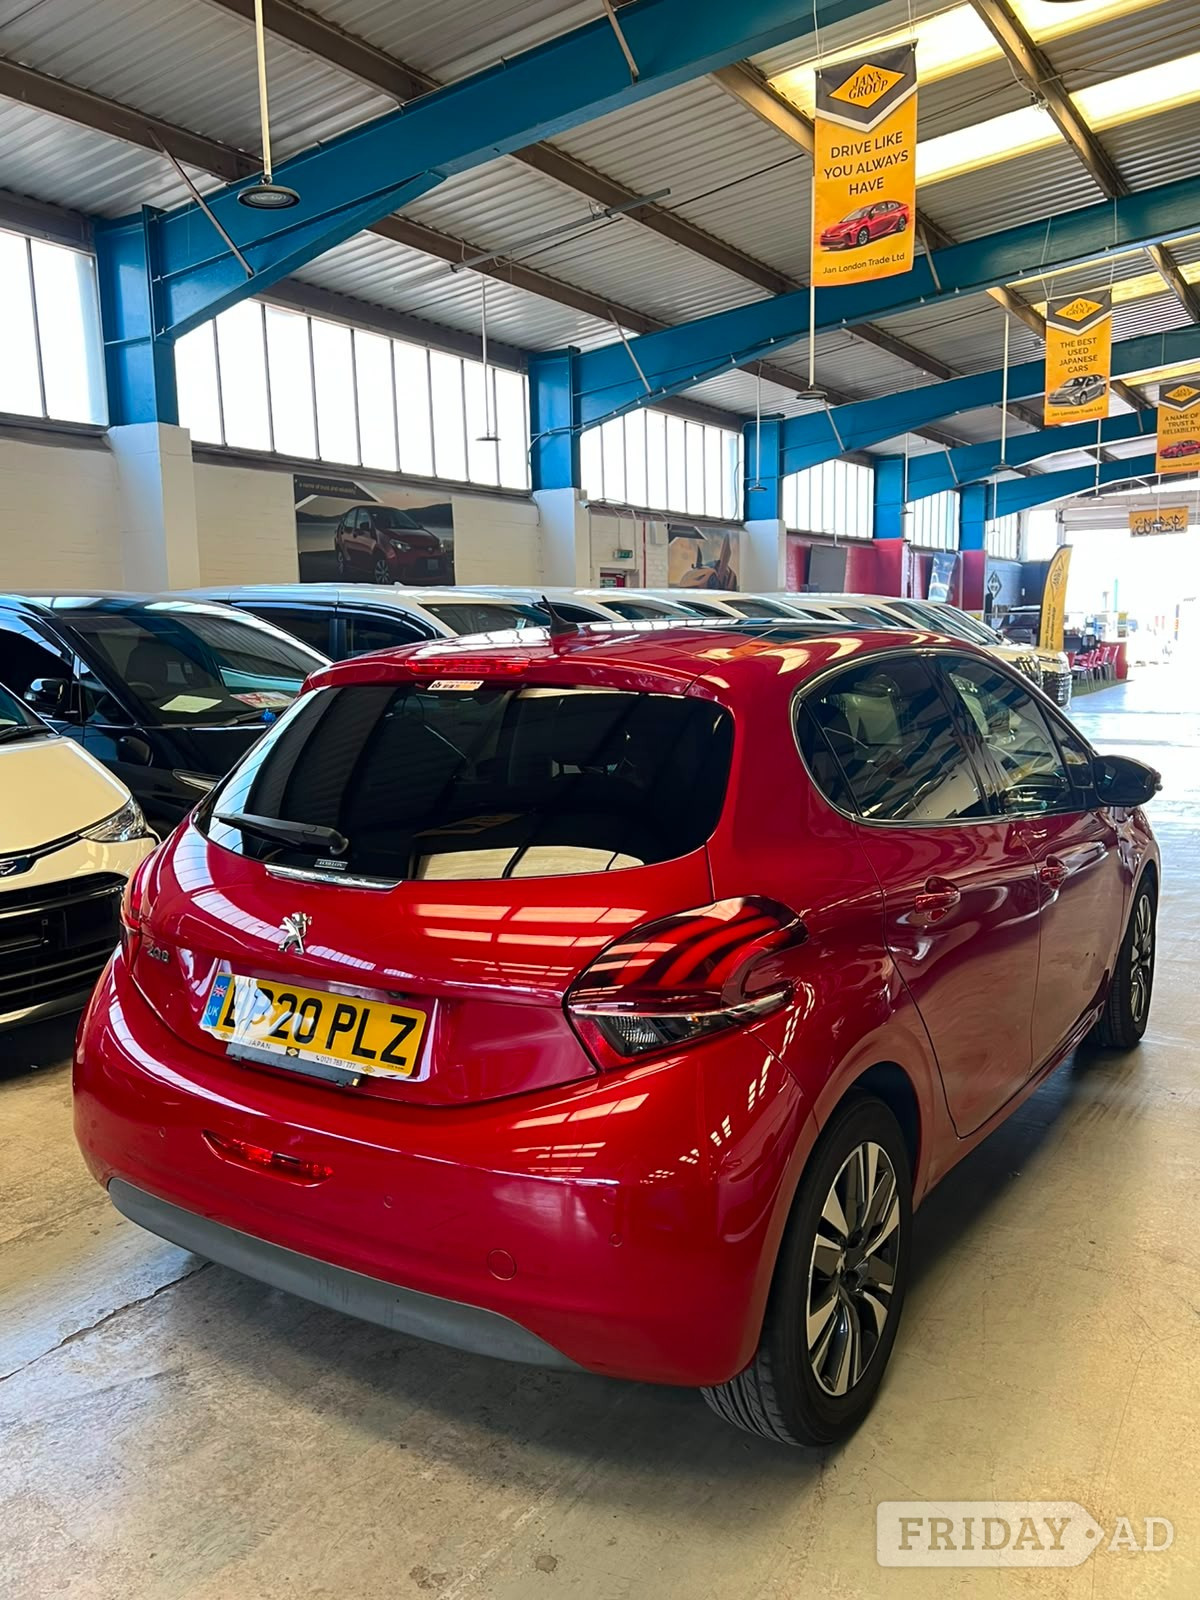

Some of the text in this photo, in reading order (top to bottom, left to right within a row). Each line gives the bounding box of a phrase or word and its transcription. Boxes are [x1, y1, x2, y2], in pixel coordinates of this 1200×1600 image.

[848, 79, 889, 99] GROUP
[831, 131, 903, 159] DRIVE LIKE
[824, 150, 909, 179] YOU ALWAYS
[849, 176, 884, 195] HAVE
[822, 252, 905, 274] Jan London Trade Ltd
[1060, 337, 1097, 349] THE BEST
[1067, 347, 1089, 357] USED
[1059, 354, 1098, 367] JAPANESE
[1067, 364, 1089, 374] CARS
[1170, 413, 1189, 421] NAME
[1168, 420, 1189, 428] TRUST
[206, 1005, 220, 1017] UK
[326, 1002, 418, 1066] PLZ
